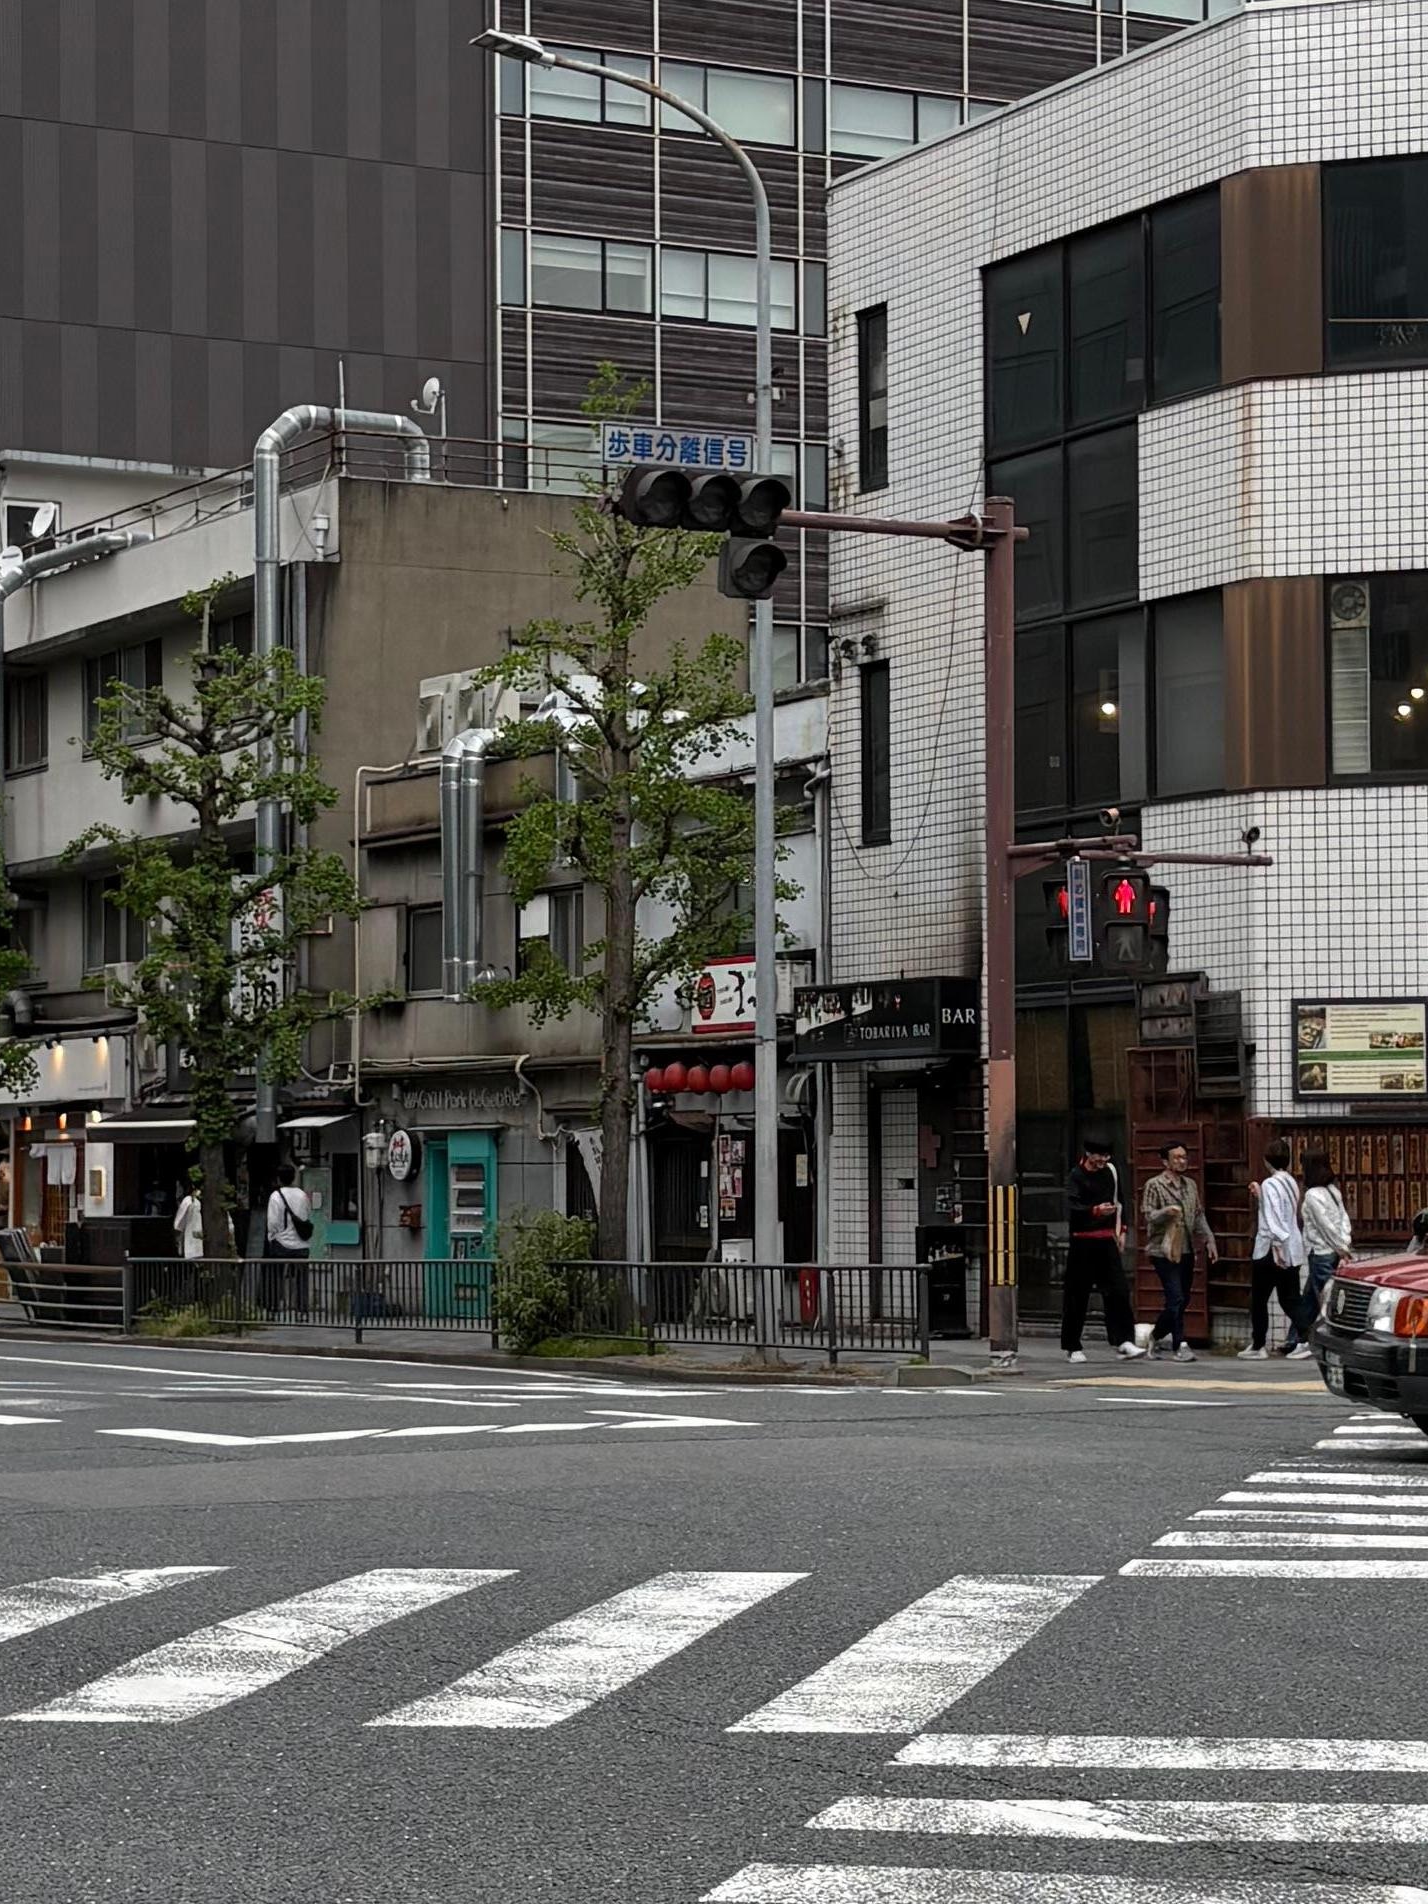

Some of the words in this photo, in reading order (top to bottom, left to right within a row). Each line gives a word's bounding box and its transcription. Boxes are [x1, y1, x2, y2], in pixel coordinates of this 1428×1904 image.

[608, 429, 748, 467] 歩車分離信号
[941, 1008, 975, 1024] BAR
[859, 1025, 908, 1040] TOBARIYA
[912, 1023, 930, 1036] BAR
